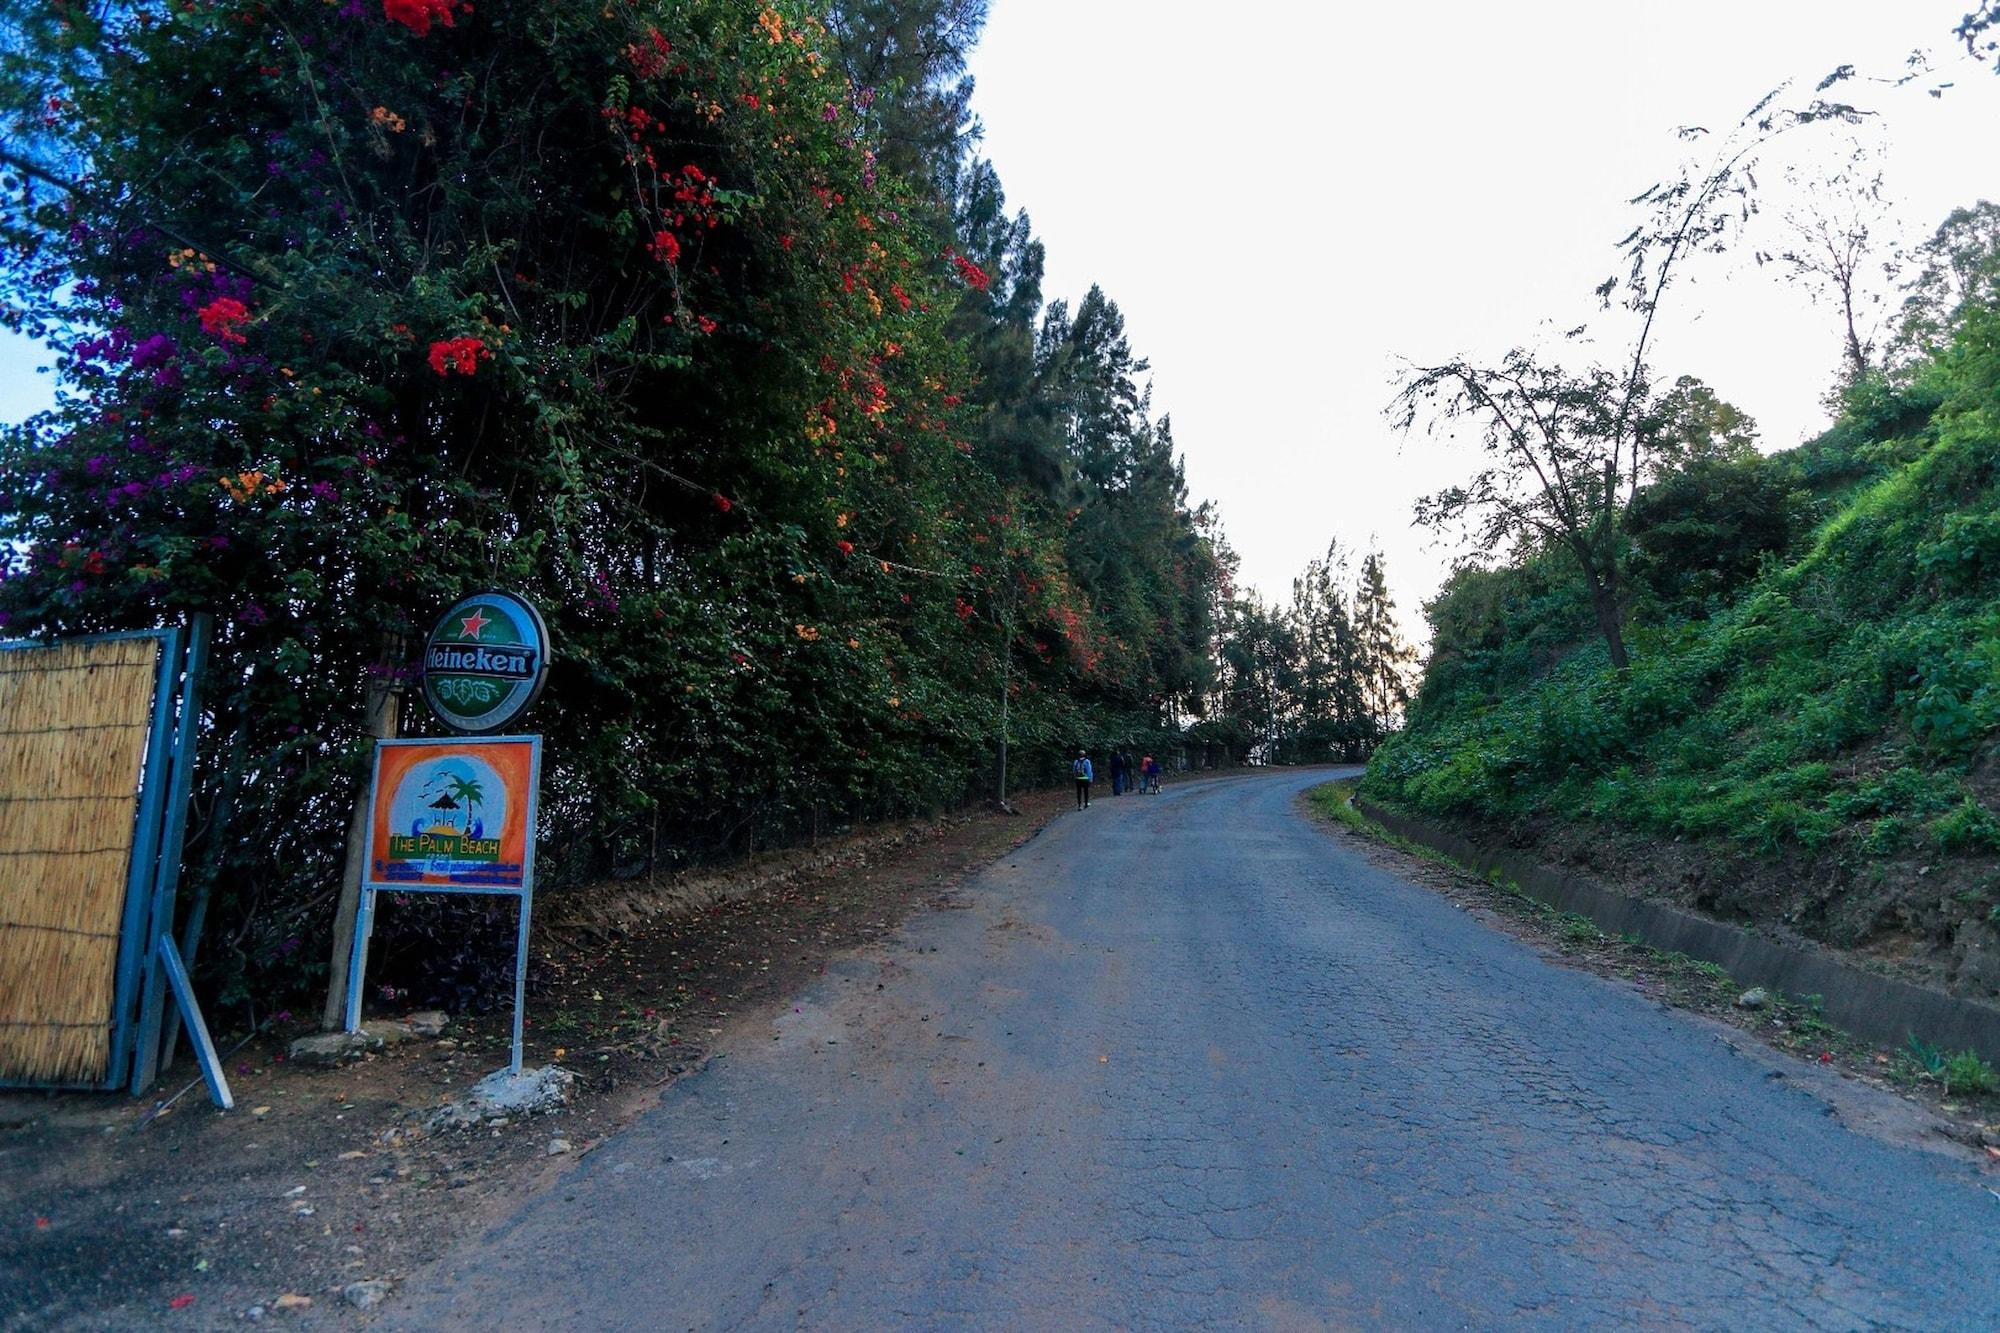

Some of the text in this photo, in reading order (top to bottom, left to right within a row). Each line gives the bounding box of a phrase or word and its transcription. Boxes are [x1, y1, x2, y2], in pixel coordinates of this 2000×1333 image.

[427, 646, 527, 674] Heineken
[391, 833, 499, 855] THE PALM BEACH
